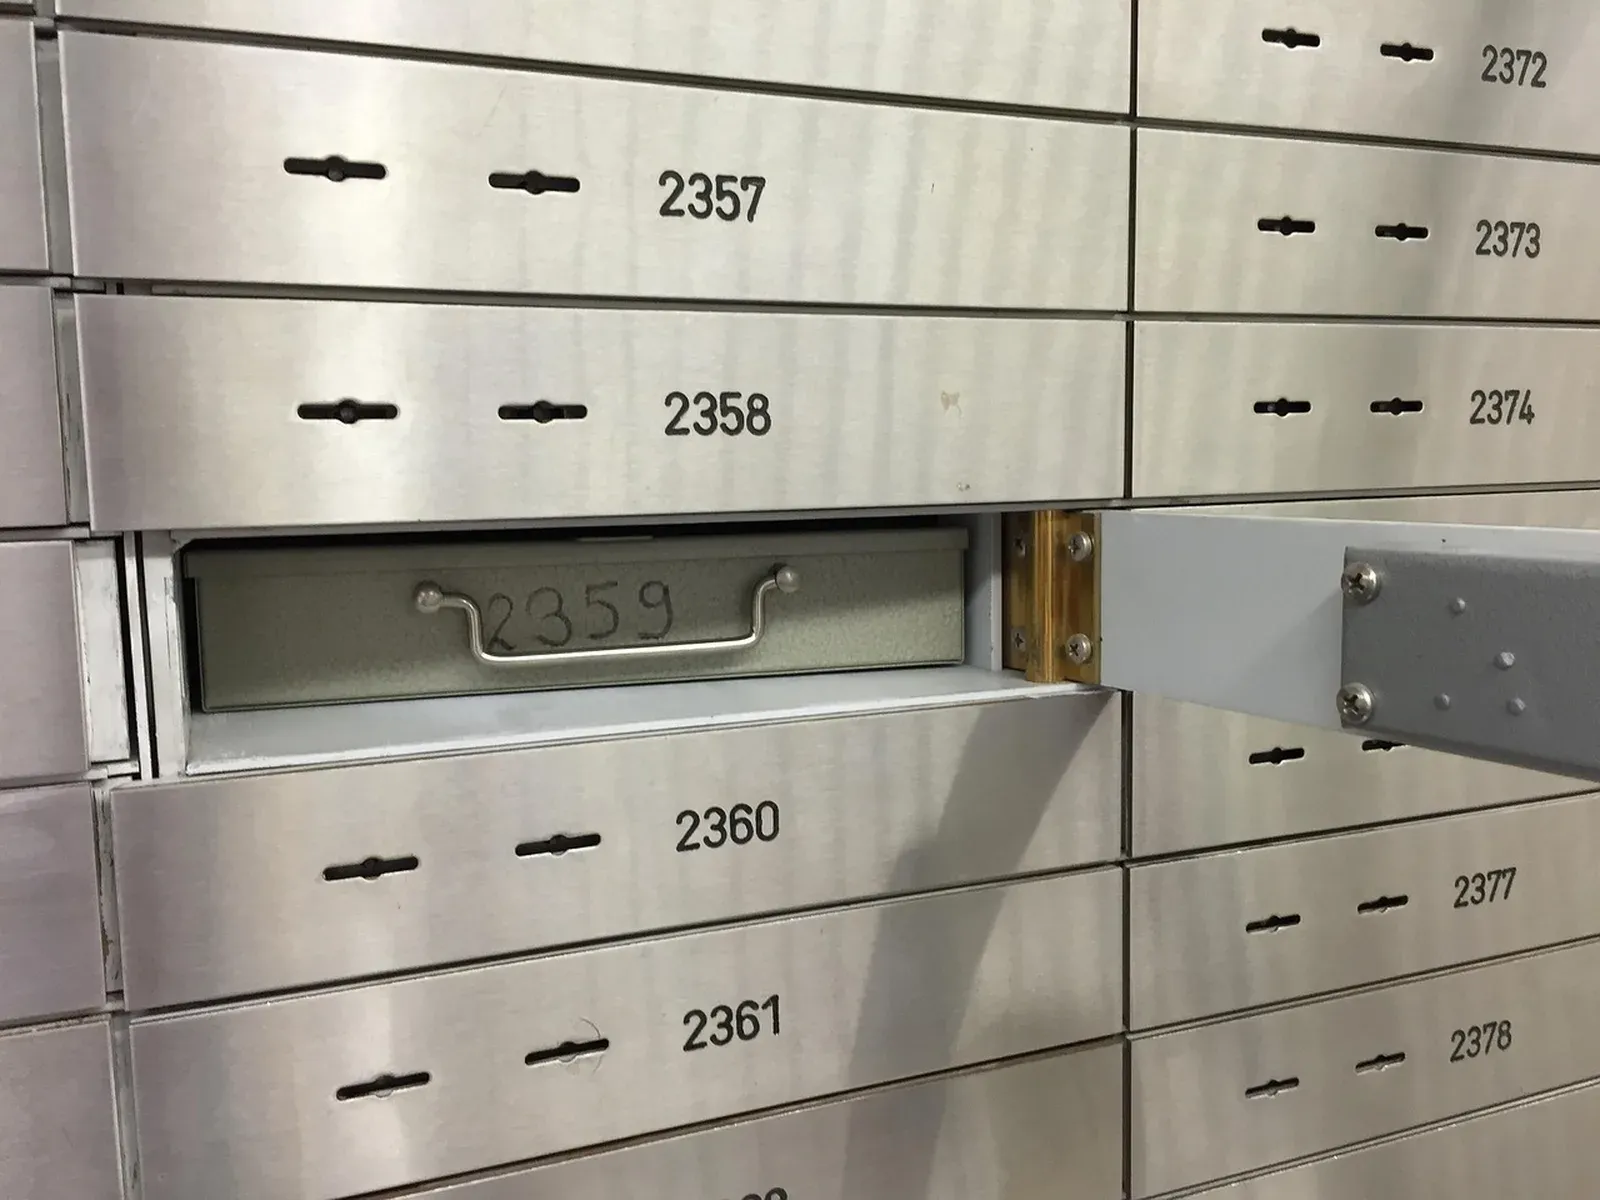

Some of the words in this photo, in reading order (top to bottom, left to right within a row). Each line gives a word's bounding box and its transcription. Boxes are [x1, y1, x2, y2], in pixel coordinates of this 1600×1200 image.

[1481, 45, 1548, 88] 2372
[659, 170, 765, 222] 2357
[1475, 219, 1541, 258] 2373
[665, 391, 771, 436] 2358
[1469, 388, 1535, 425] 2374
[484, 580, 674, 653] 2359
[676, 801, 779, 852] 2360
[1453, 866, 1517, 909] 2377
[683, 994, 780, 1051] 2361
[1450, 1020, 1511, 1063] 2378
